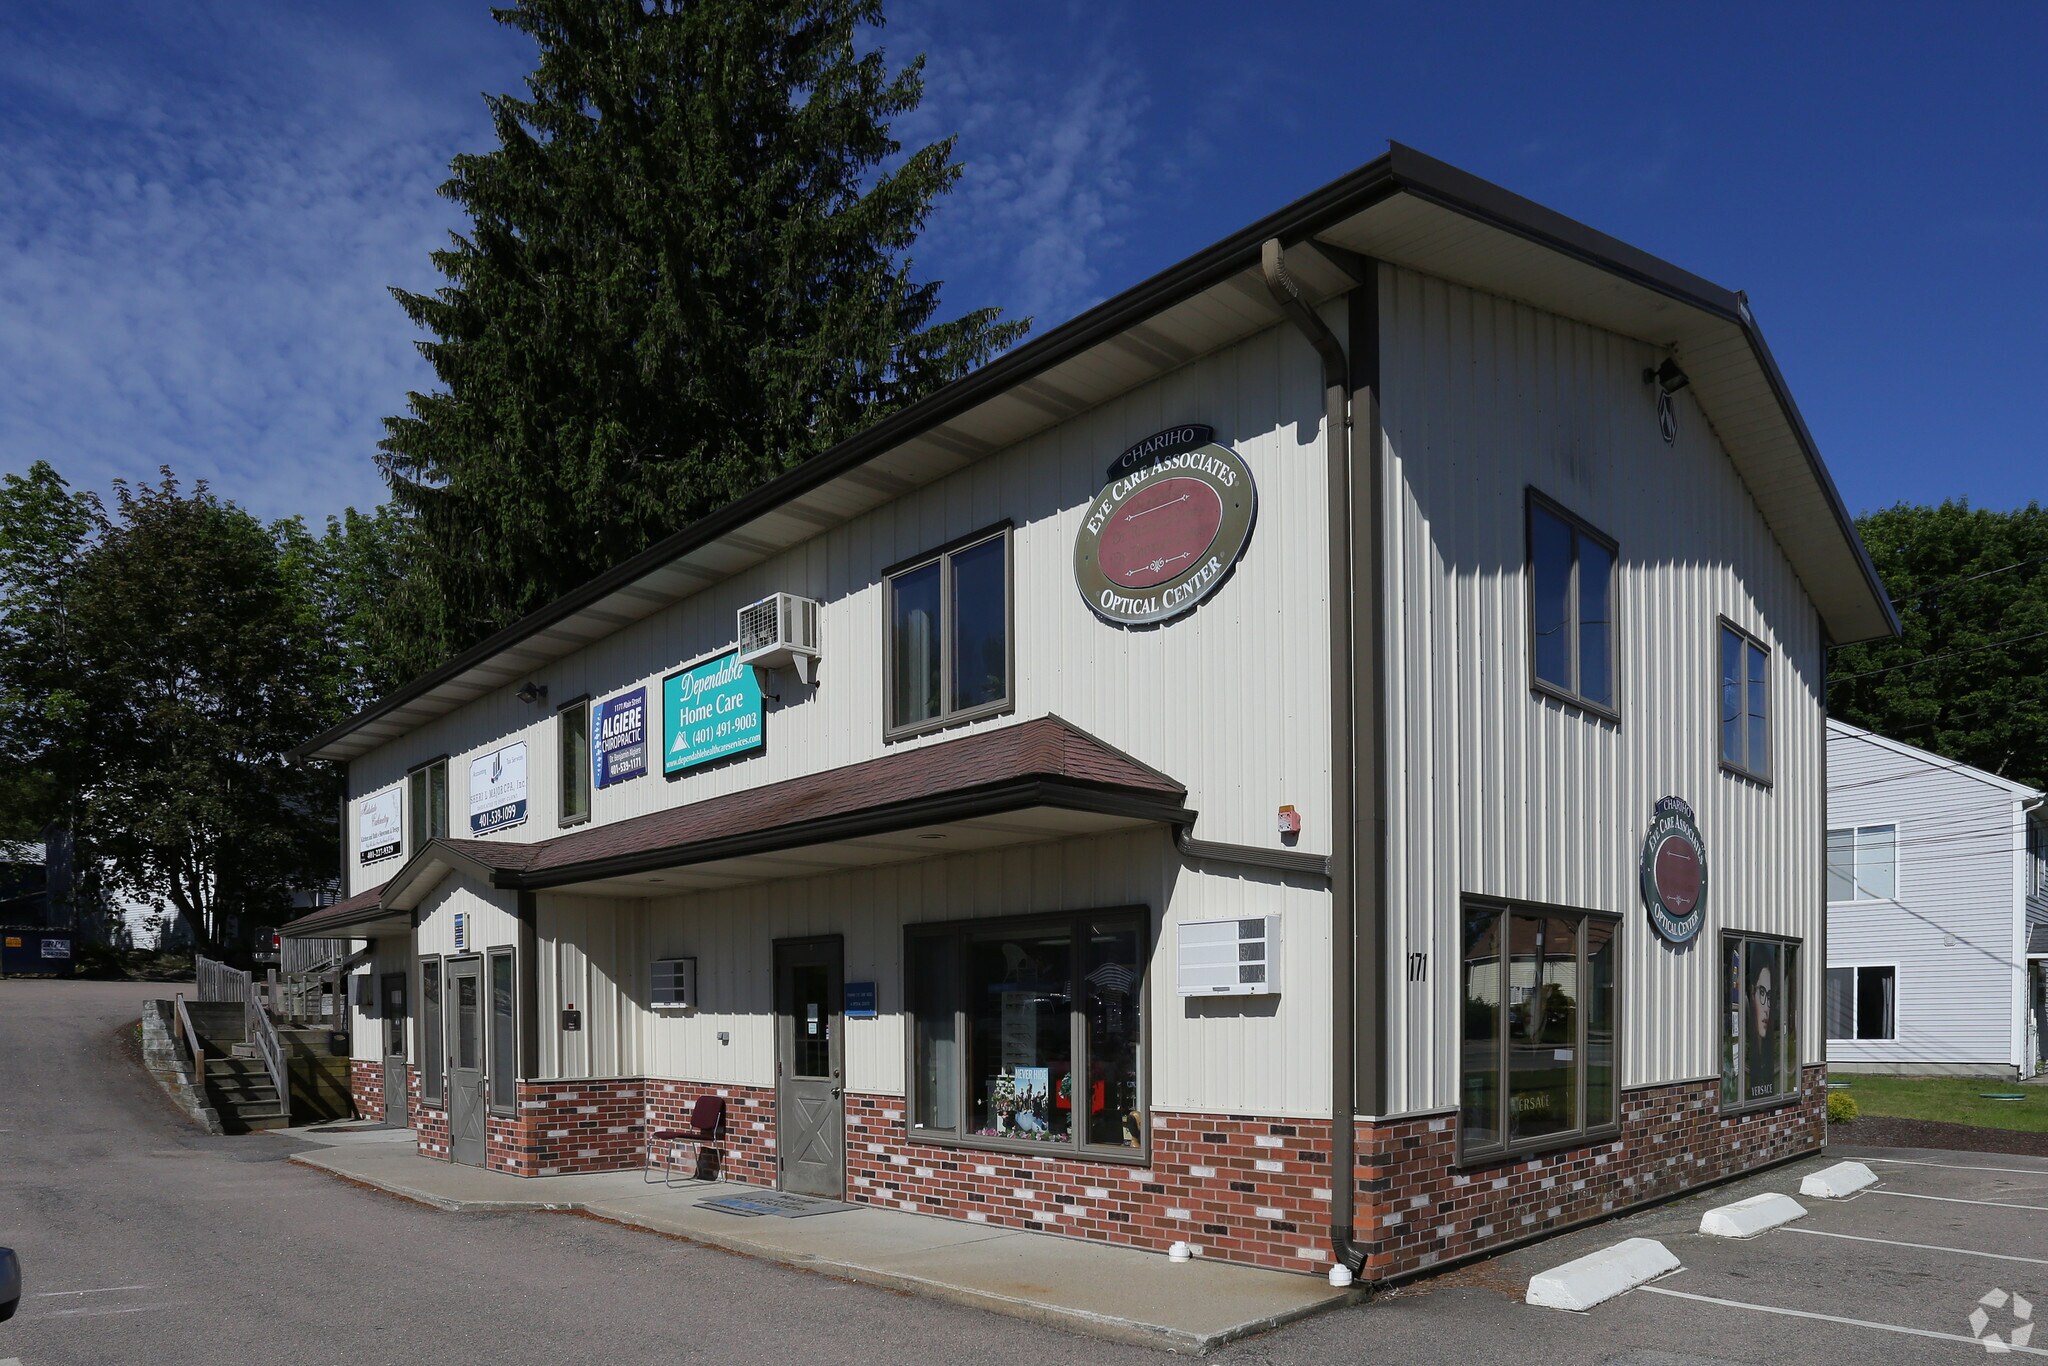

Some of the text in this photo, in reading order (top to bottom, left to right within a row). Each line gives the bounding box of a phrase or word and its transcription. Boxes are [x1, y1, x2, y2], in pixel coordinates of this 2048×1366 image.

[1121, 429, 1195, 468] CHARIHO
[1086, 452, 1237, 536] EYE CARE ASSOCIATES
[1100, 555, 1223, 614] OPTICAL CENTER
[680, 653, 744, 706] Dependable
[602, 706, 642, 739] ALGIERE
[680, 692, 744, 728] Home Care
[602, 728, 642, 753] CHIROPRACTIC
[692, 712, 757, 747] (401) 491-9003
[610, 756, 642, 775] 401-539-1171
[479, 804, 517, 827] 401-539-1099
[1664, 798, 1692, 818] CHARIHO
[1649, 814, 1703, 865] EYE CARE ASSOCIATES
[1655, 903, 1699, 936] OPTICAL CENTER
[1016, 1068, 1048, 1080] NEVER HIDE
[1751, 1083, 1773, 1097] VERSACE
